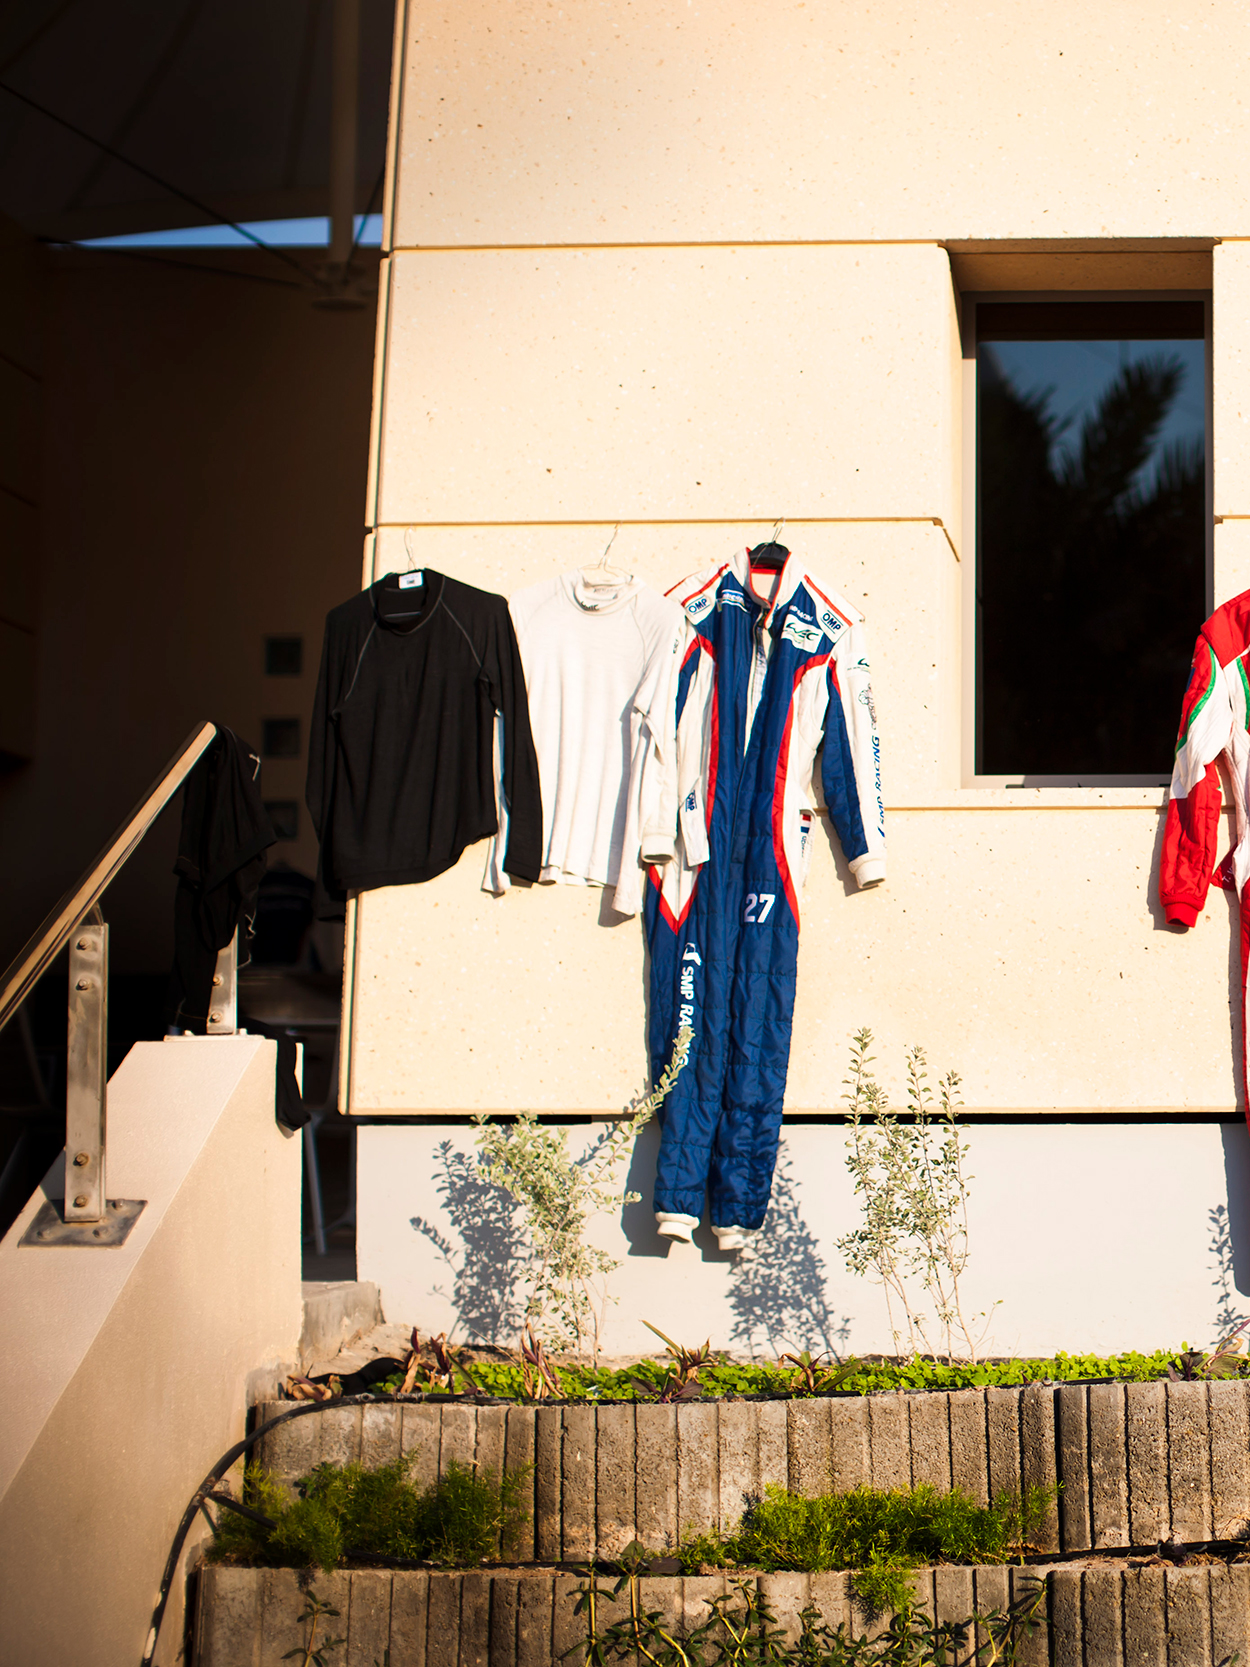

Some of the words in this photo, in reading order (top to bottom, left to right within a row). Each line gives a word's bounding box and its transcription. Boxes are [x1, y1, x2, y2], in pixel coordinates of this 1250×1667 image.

[688, 598, 708, 613] OMP
[822, 612, 842, 631] OMP
[743, 893, 776, 923] 27
[680, 965, 695, 1001] SMP
[678, 1003, 695, 1067] RAG
